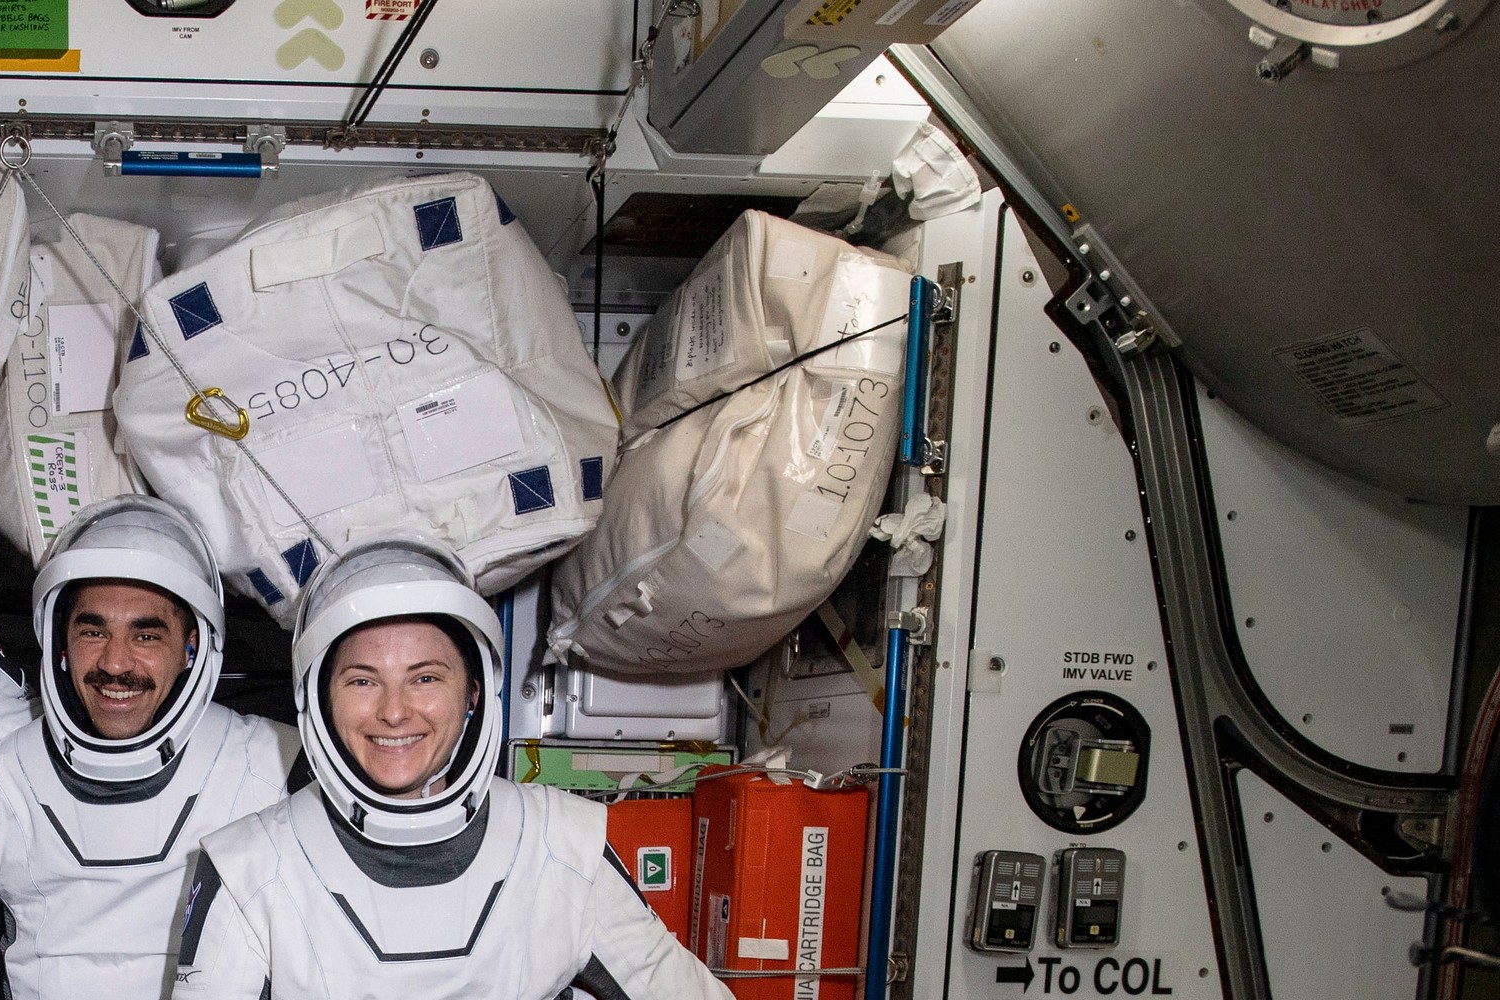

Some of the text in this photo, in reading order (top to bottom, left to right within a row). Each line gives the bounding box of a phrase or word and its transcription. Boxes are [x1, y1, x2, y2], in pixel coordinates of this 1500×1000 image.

[28, 14, 50, 22] BAGS
[249, 322, 450, 421] 3.0-4085
[818, 378, 889, 503] 1.0-1073
[55, 446, 66, 491] CREW-3
[1063, 667, 1133, 681] IMV VALVE
[1064, 652, 1134, 665] STDB FWD
[807, 832, 825, 868] BAG
[691, 865, 702, 948] ARTRIDGE
[800, 874, 822, 974] CARTRIDGE
[1038, 958, 1172, 995] To COL
